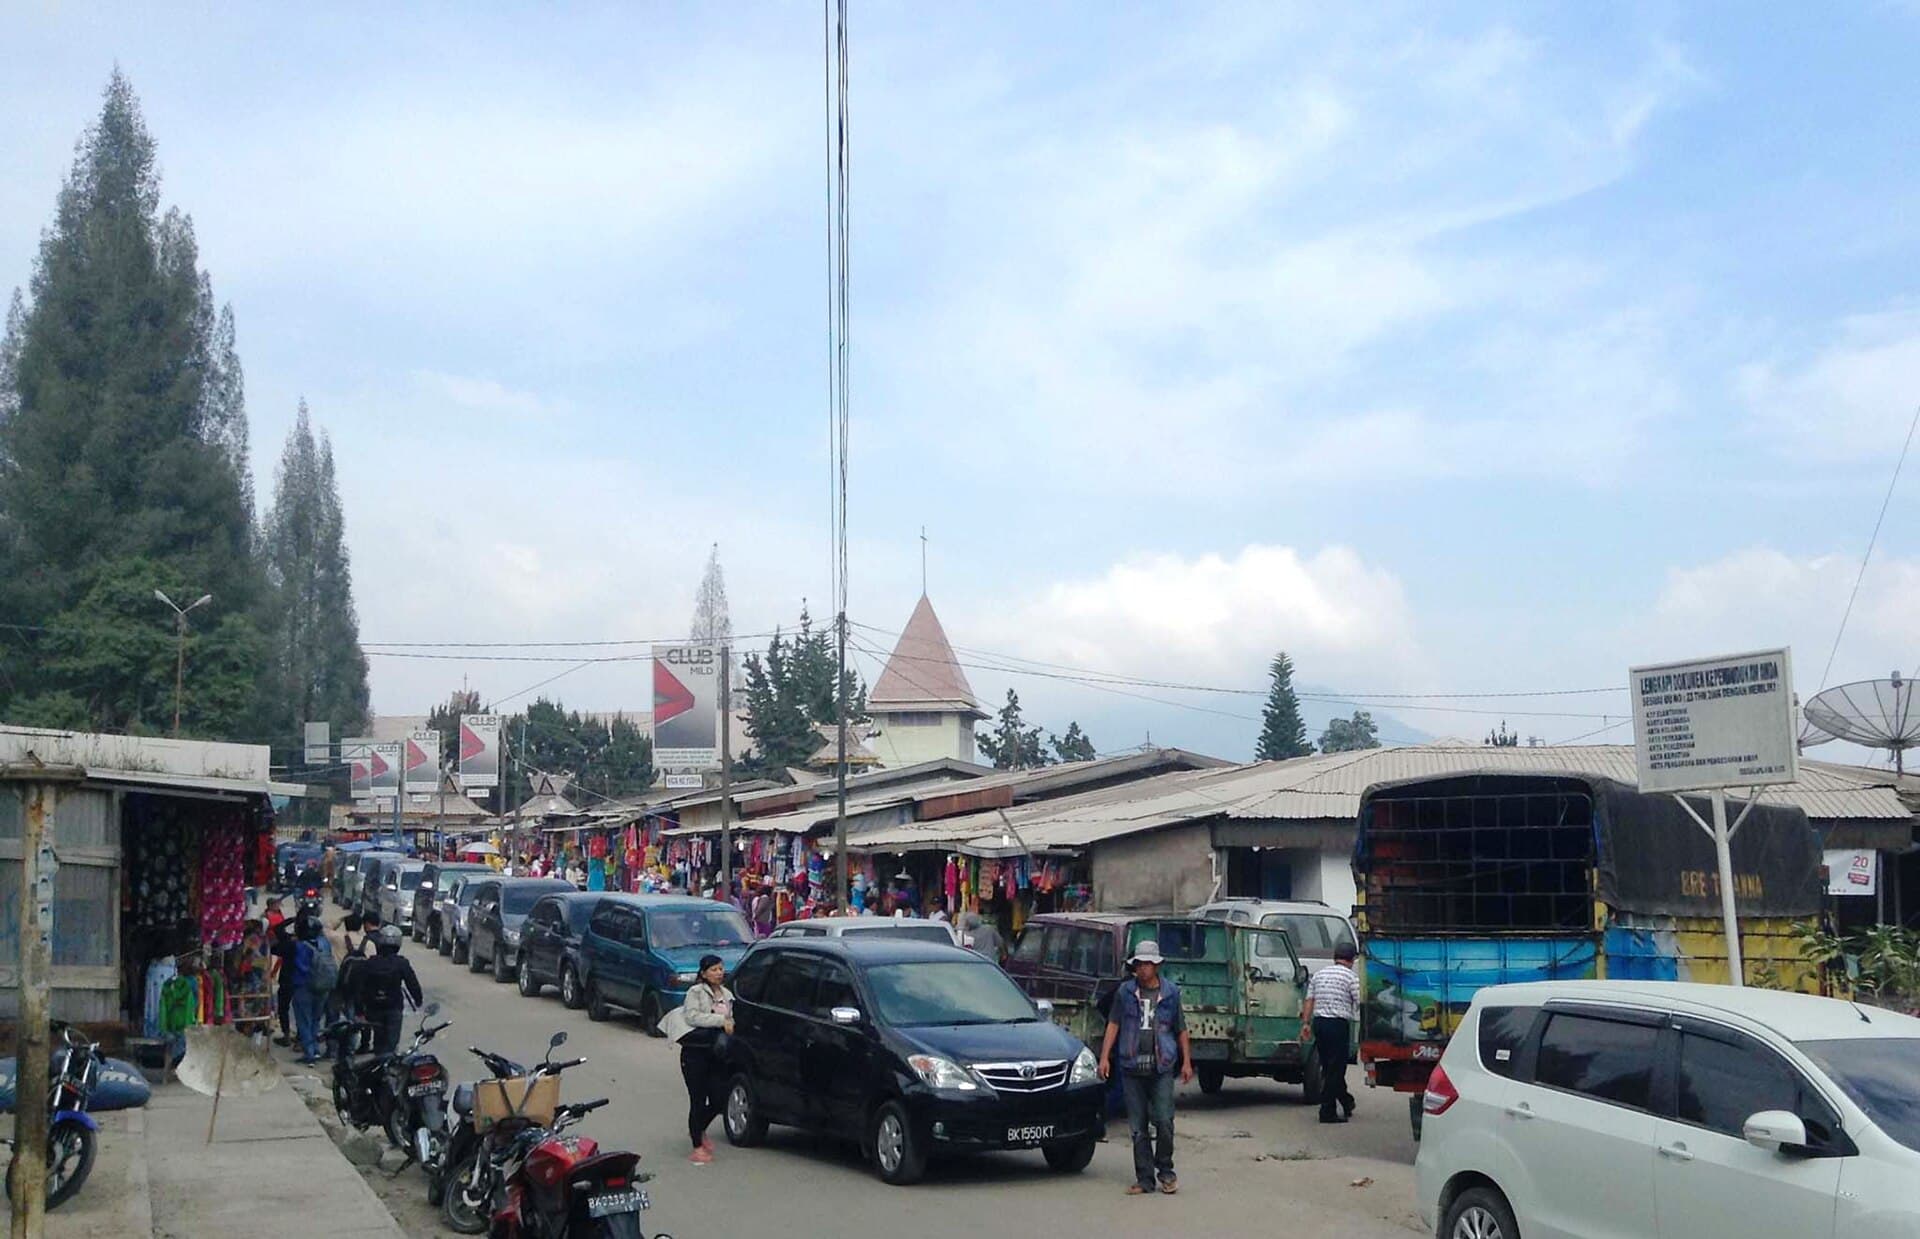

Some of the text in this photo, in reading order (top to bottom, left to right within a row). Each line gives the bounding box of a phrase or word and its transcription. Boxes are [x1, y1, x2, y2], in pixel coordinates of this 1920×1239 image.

[666, 648, 713, 664] CLUB
[690, 666, 713, 675] MILD
[468, 716, 497, 726] CLUB
[1852, 856, 1868, 868] 20
[1008, 1125, 1055, 1141] BK 1550 KT
